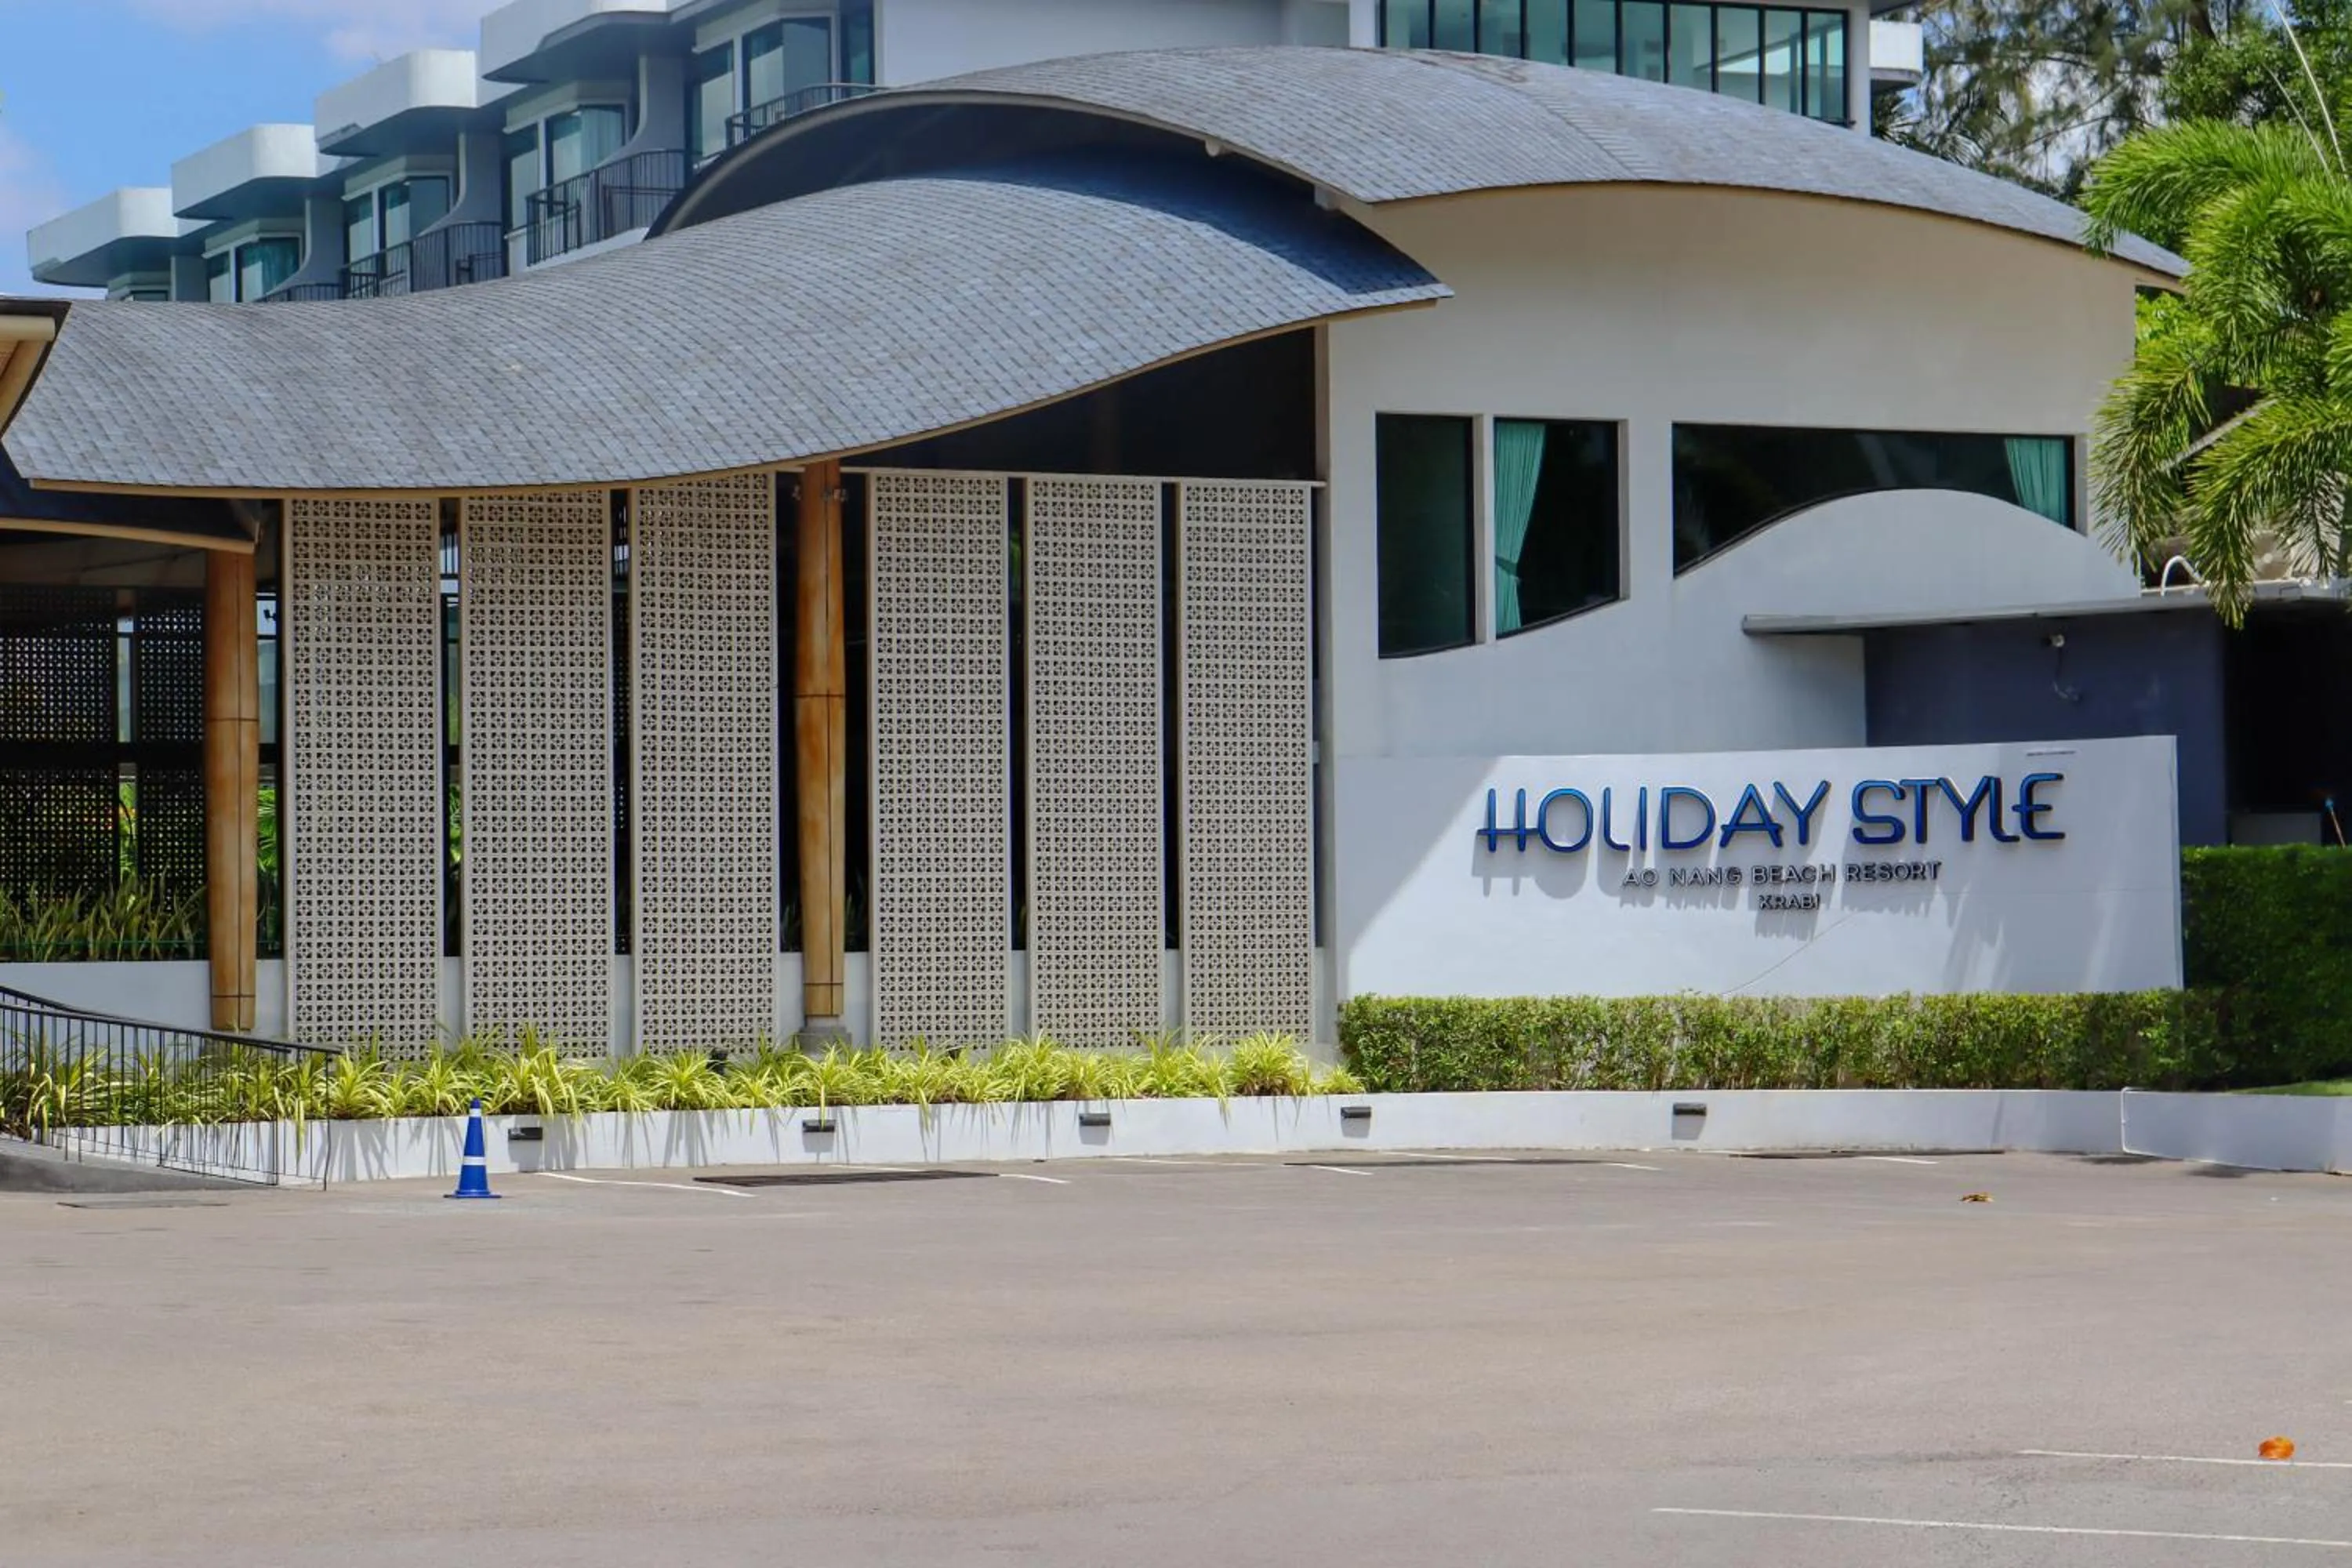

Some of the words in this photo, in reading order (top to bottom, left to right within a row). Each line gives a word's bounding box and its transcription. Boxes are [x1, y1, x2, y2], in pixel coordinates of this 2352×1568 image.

[1477, 780, 1832, 853] HOLIDAY
[1851, 772, 2066, 845] STYLE
[1622, 868, 1659, 887] AO
[1668, 866, 1743, 887] NANG
[1750, 863, 1837, 885] BEACH
[1844, 861, 1942, 883] RESORT
[1759, 893, 1820, 910] KRABI
